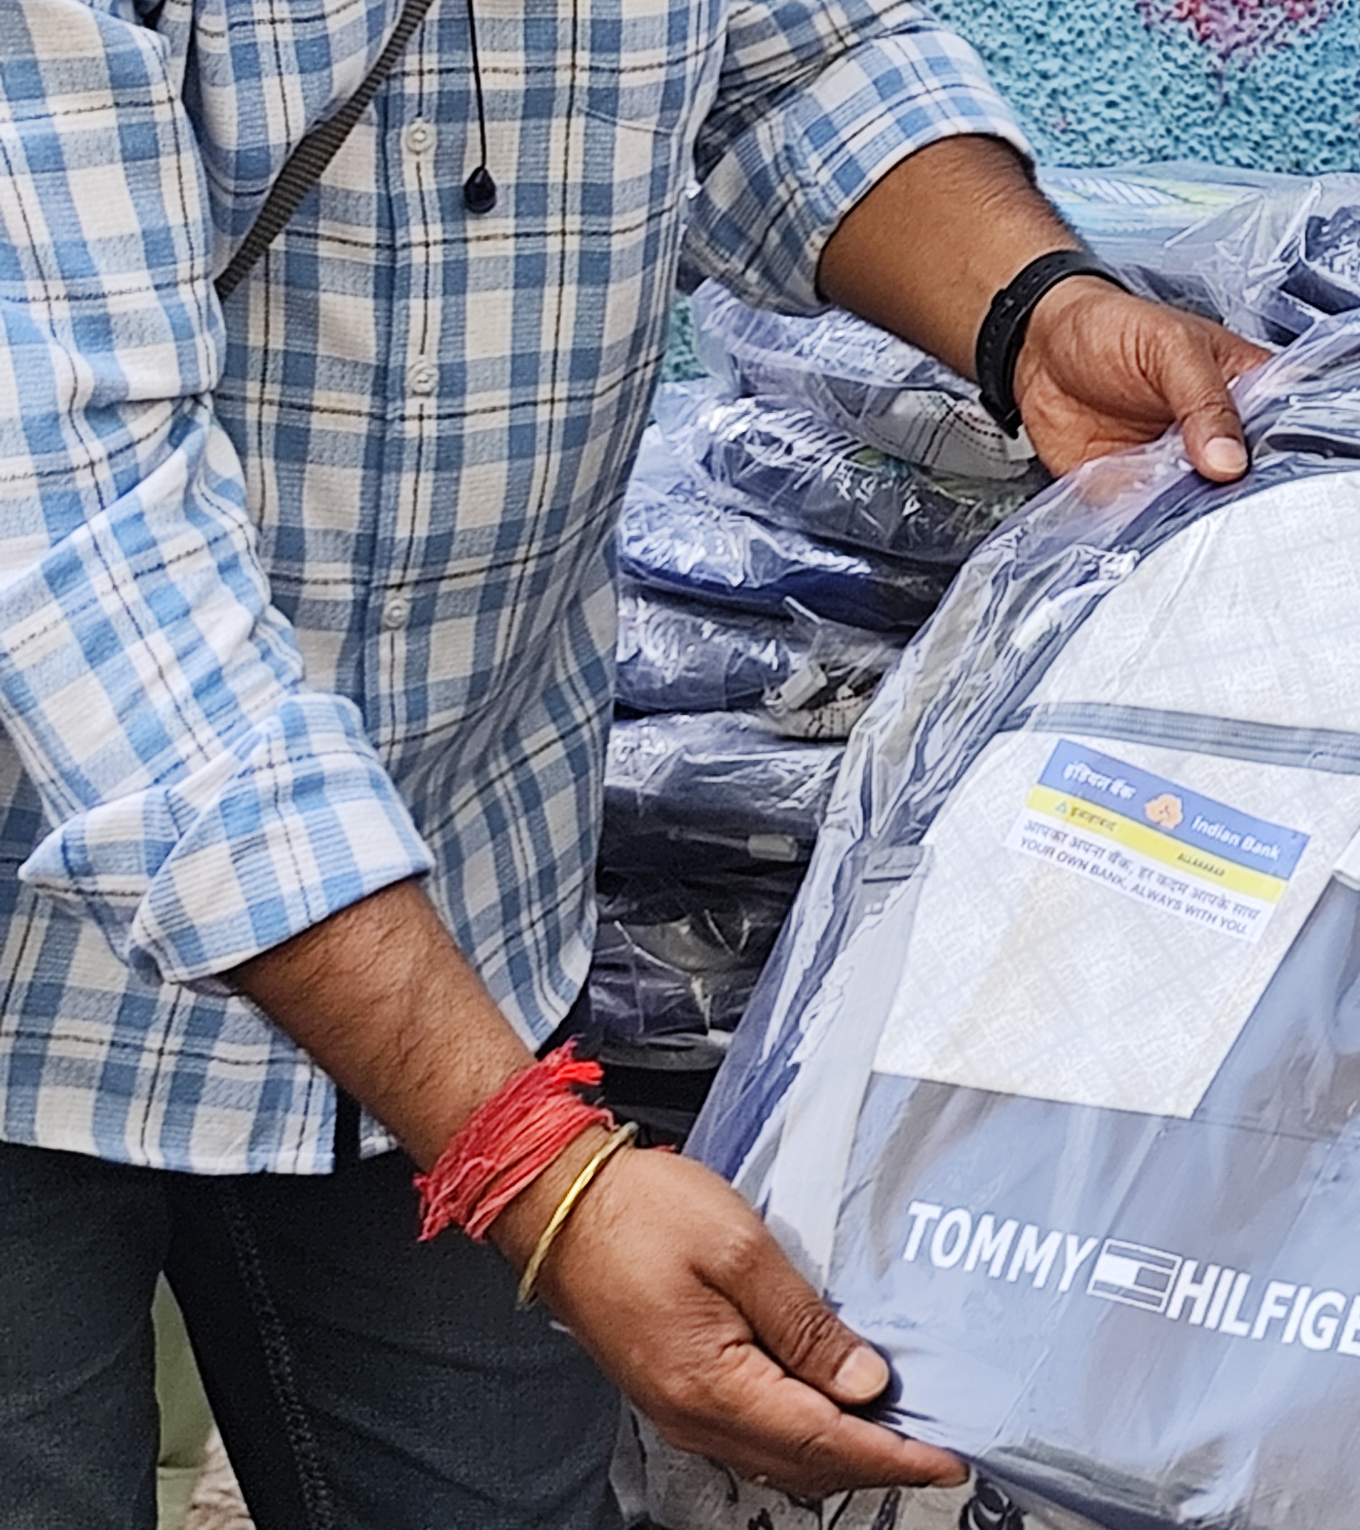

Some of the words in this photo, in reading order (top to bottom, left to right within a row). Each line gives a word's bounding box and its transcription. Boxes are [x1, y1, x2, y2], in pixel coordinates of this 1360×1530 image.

[1020, 835, 1056, 858] YOUR
[1056, 849, 1090, 871] OWN
[1130, 883, 1183, 911] ALWAYS
[1184, 899, 1218, 924] WITH
[1191, 814, 1241, 848] Indian
[1240, 834, 1281, 861] Bank
[901, 1200, 1099, 1294] TOMMY
